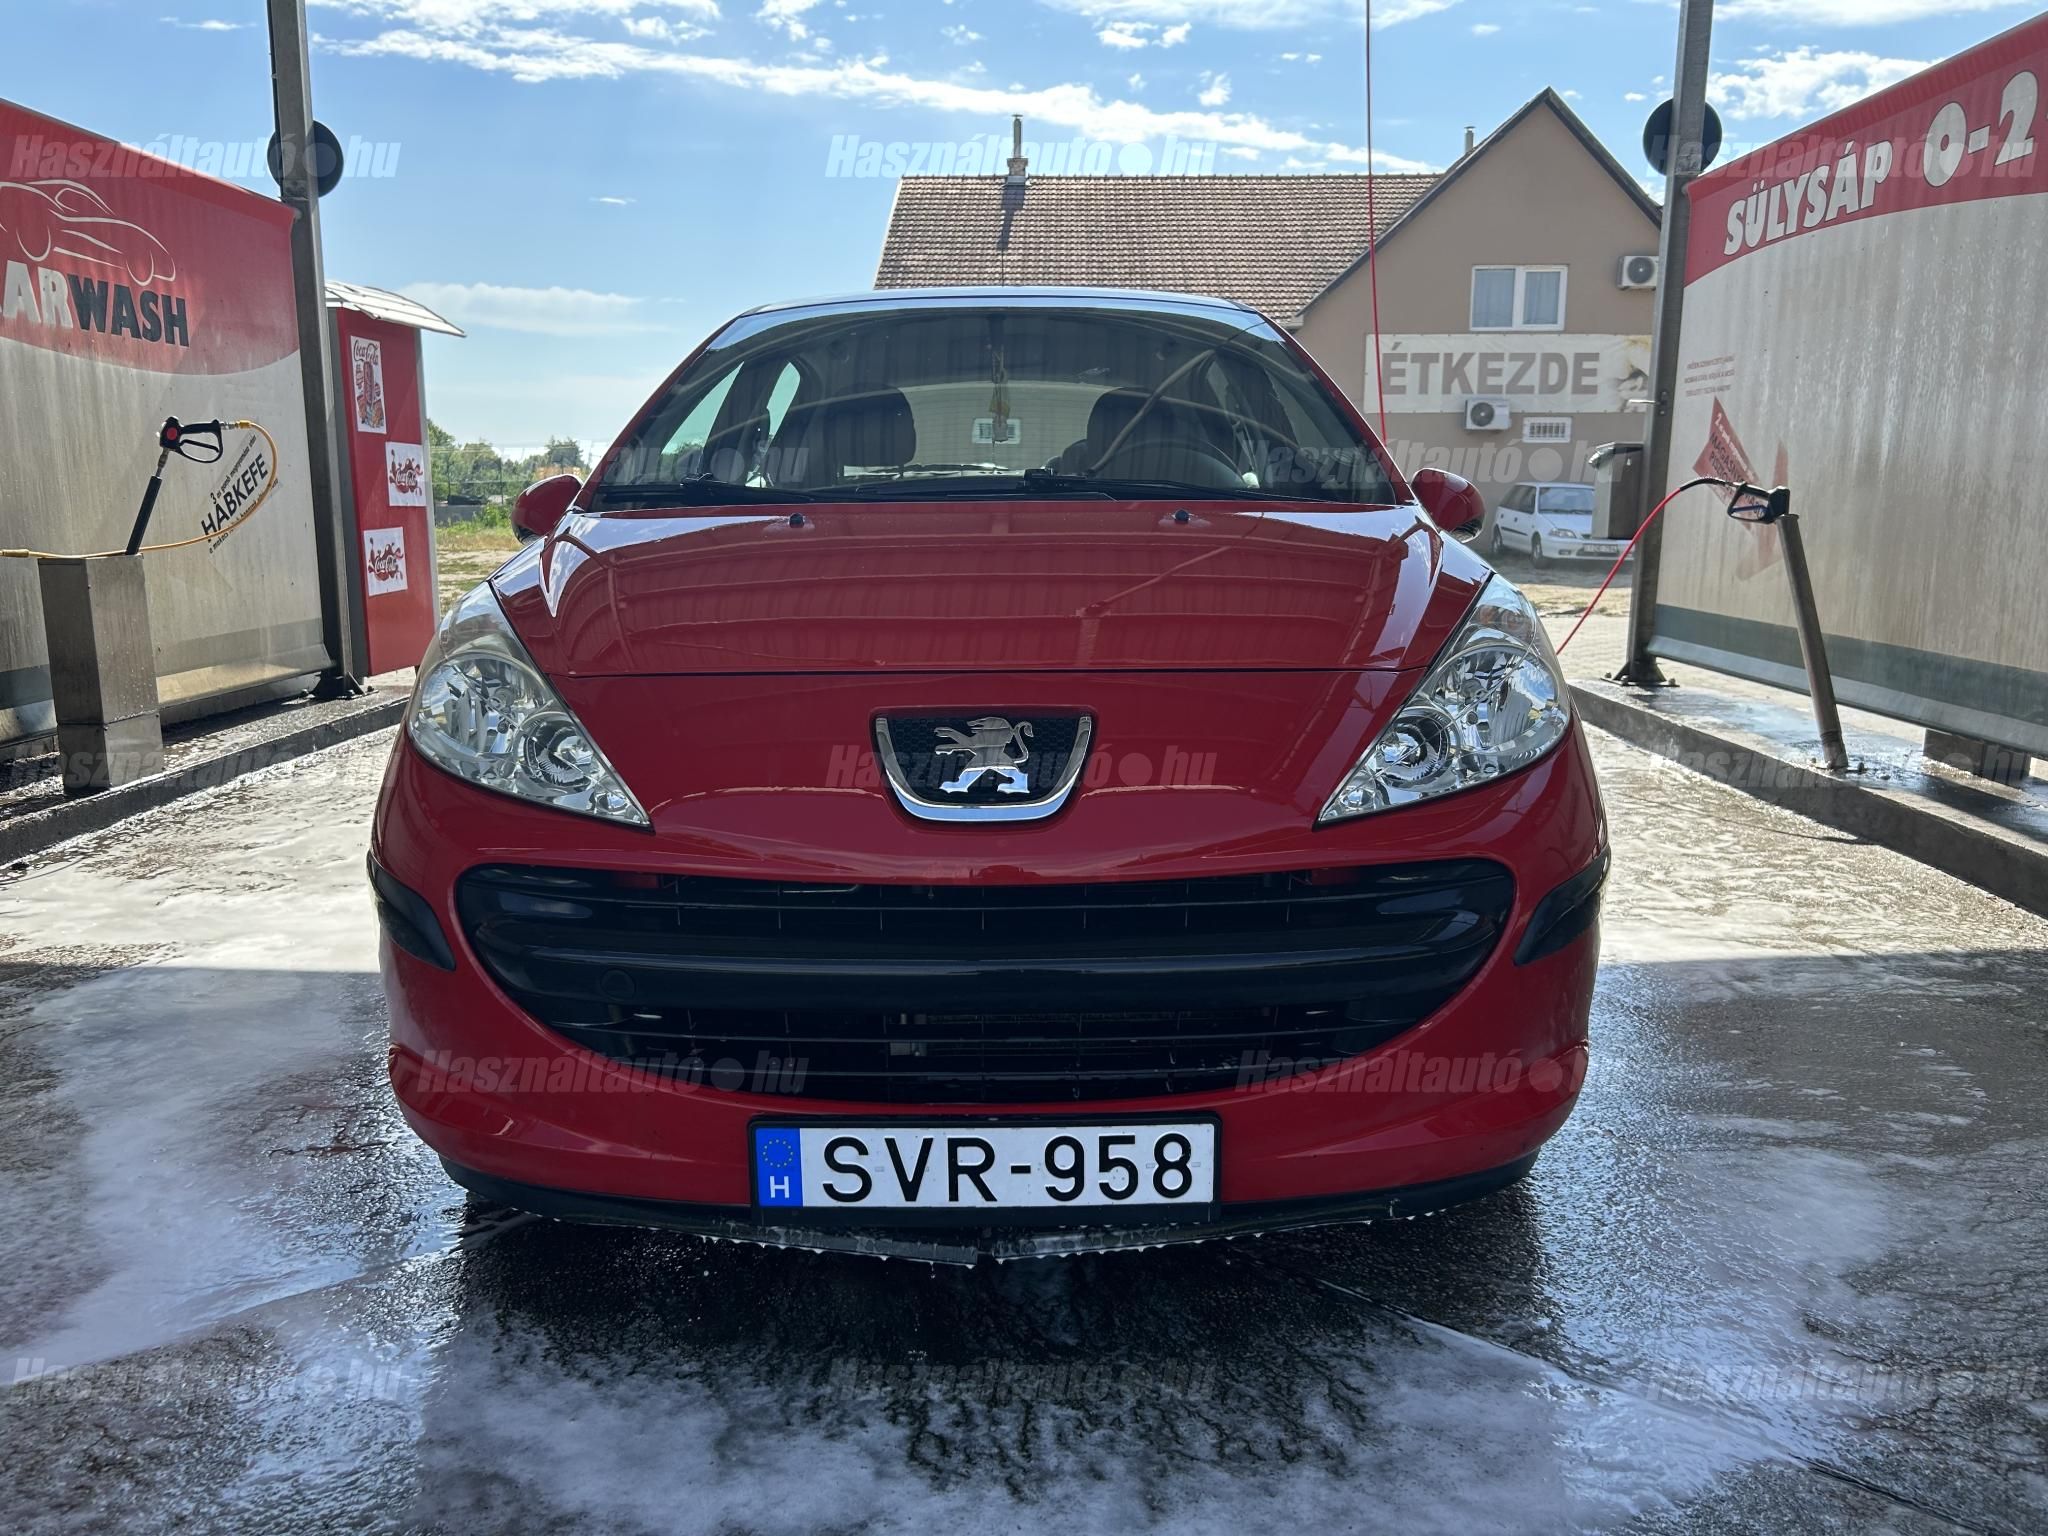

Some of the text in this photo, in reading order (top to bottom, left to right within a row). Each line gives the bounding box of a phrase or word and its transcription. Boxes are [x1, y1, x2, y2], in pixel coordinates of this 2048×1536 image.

[1724, 70, 2048, 257] SÜLYSÁP 0-2
[0, 259, 190, 348] ARWASH
[1381, 342, 1600, 396] ÉTKEZDE
[769, 1175, 790, 1199] H
[822, 1132, 1193, 1203] SVR-958
